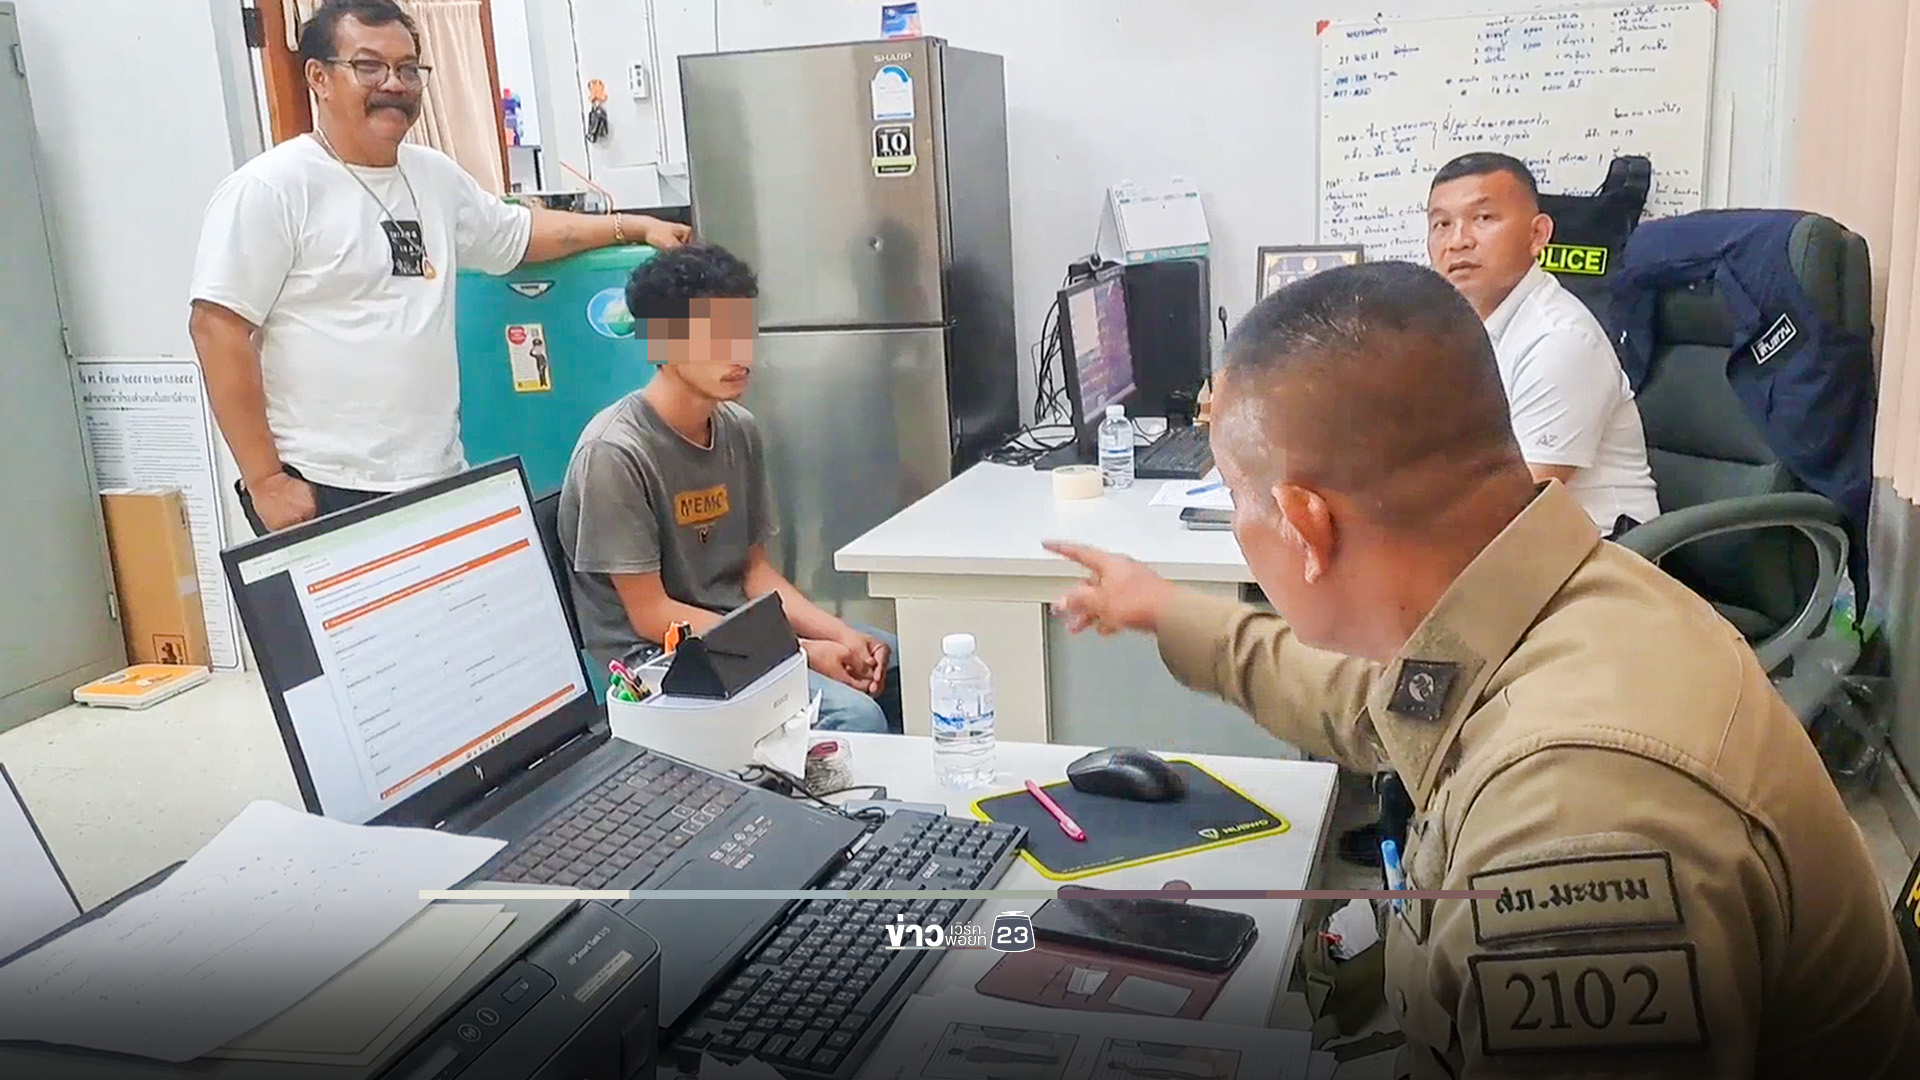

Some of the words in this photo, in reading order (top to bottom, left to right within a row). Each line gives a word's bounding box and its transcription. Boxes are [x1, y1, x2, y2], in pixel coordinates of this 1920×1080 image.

[873, 52, 912, 63] SHARP
[880, 133, 908, 152] 10
[1540, 247, 1602, 271] LICE
[1495, 877, 1650, 914] สภ.มะขาม
[1505, 964, 1668, 1031] 2102
